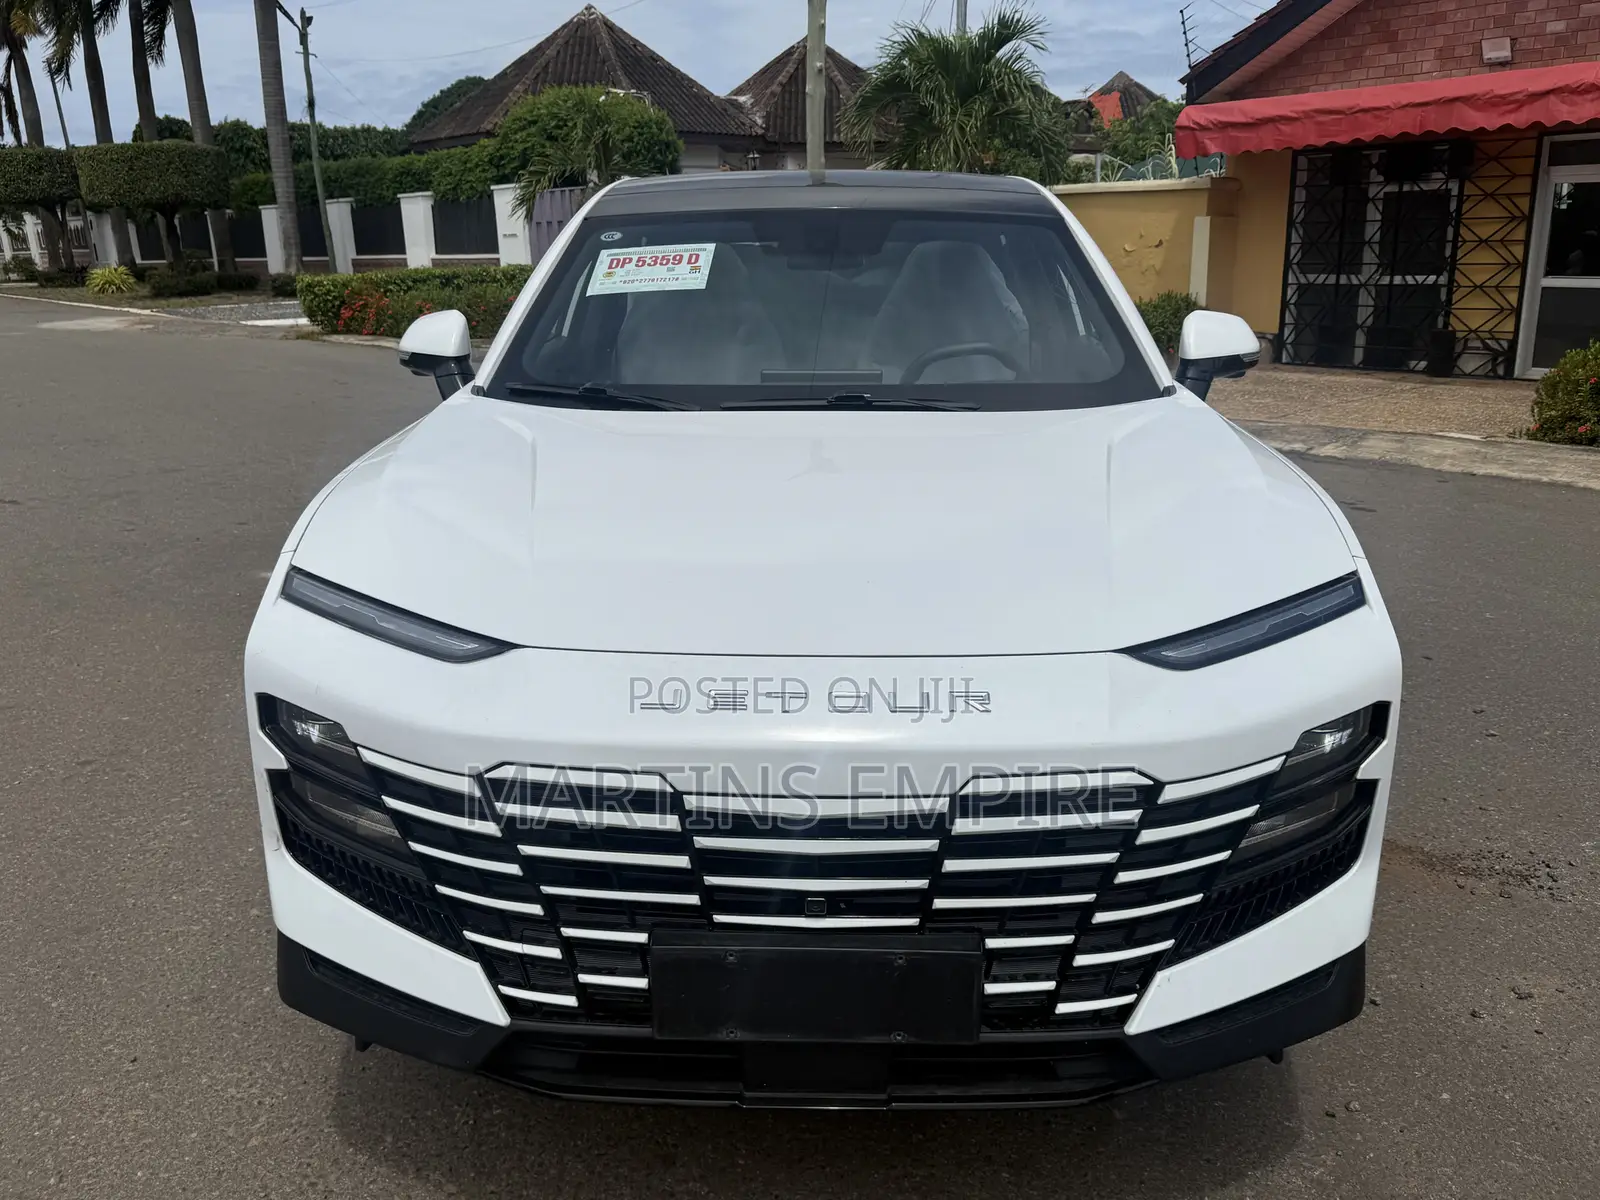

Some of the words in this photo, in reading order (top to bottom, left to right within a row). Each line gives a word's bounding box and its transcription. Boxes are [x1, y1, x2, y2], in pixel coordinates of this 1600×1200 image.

[607, 257, 633, 269] DP
[635, 254, 684, 267] 5359
[686, 253, 700, 265] D
[640, 688, 992, 713] JETOUR
